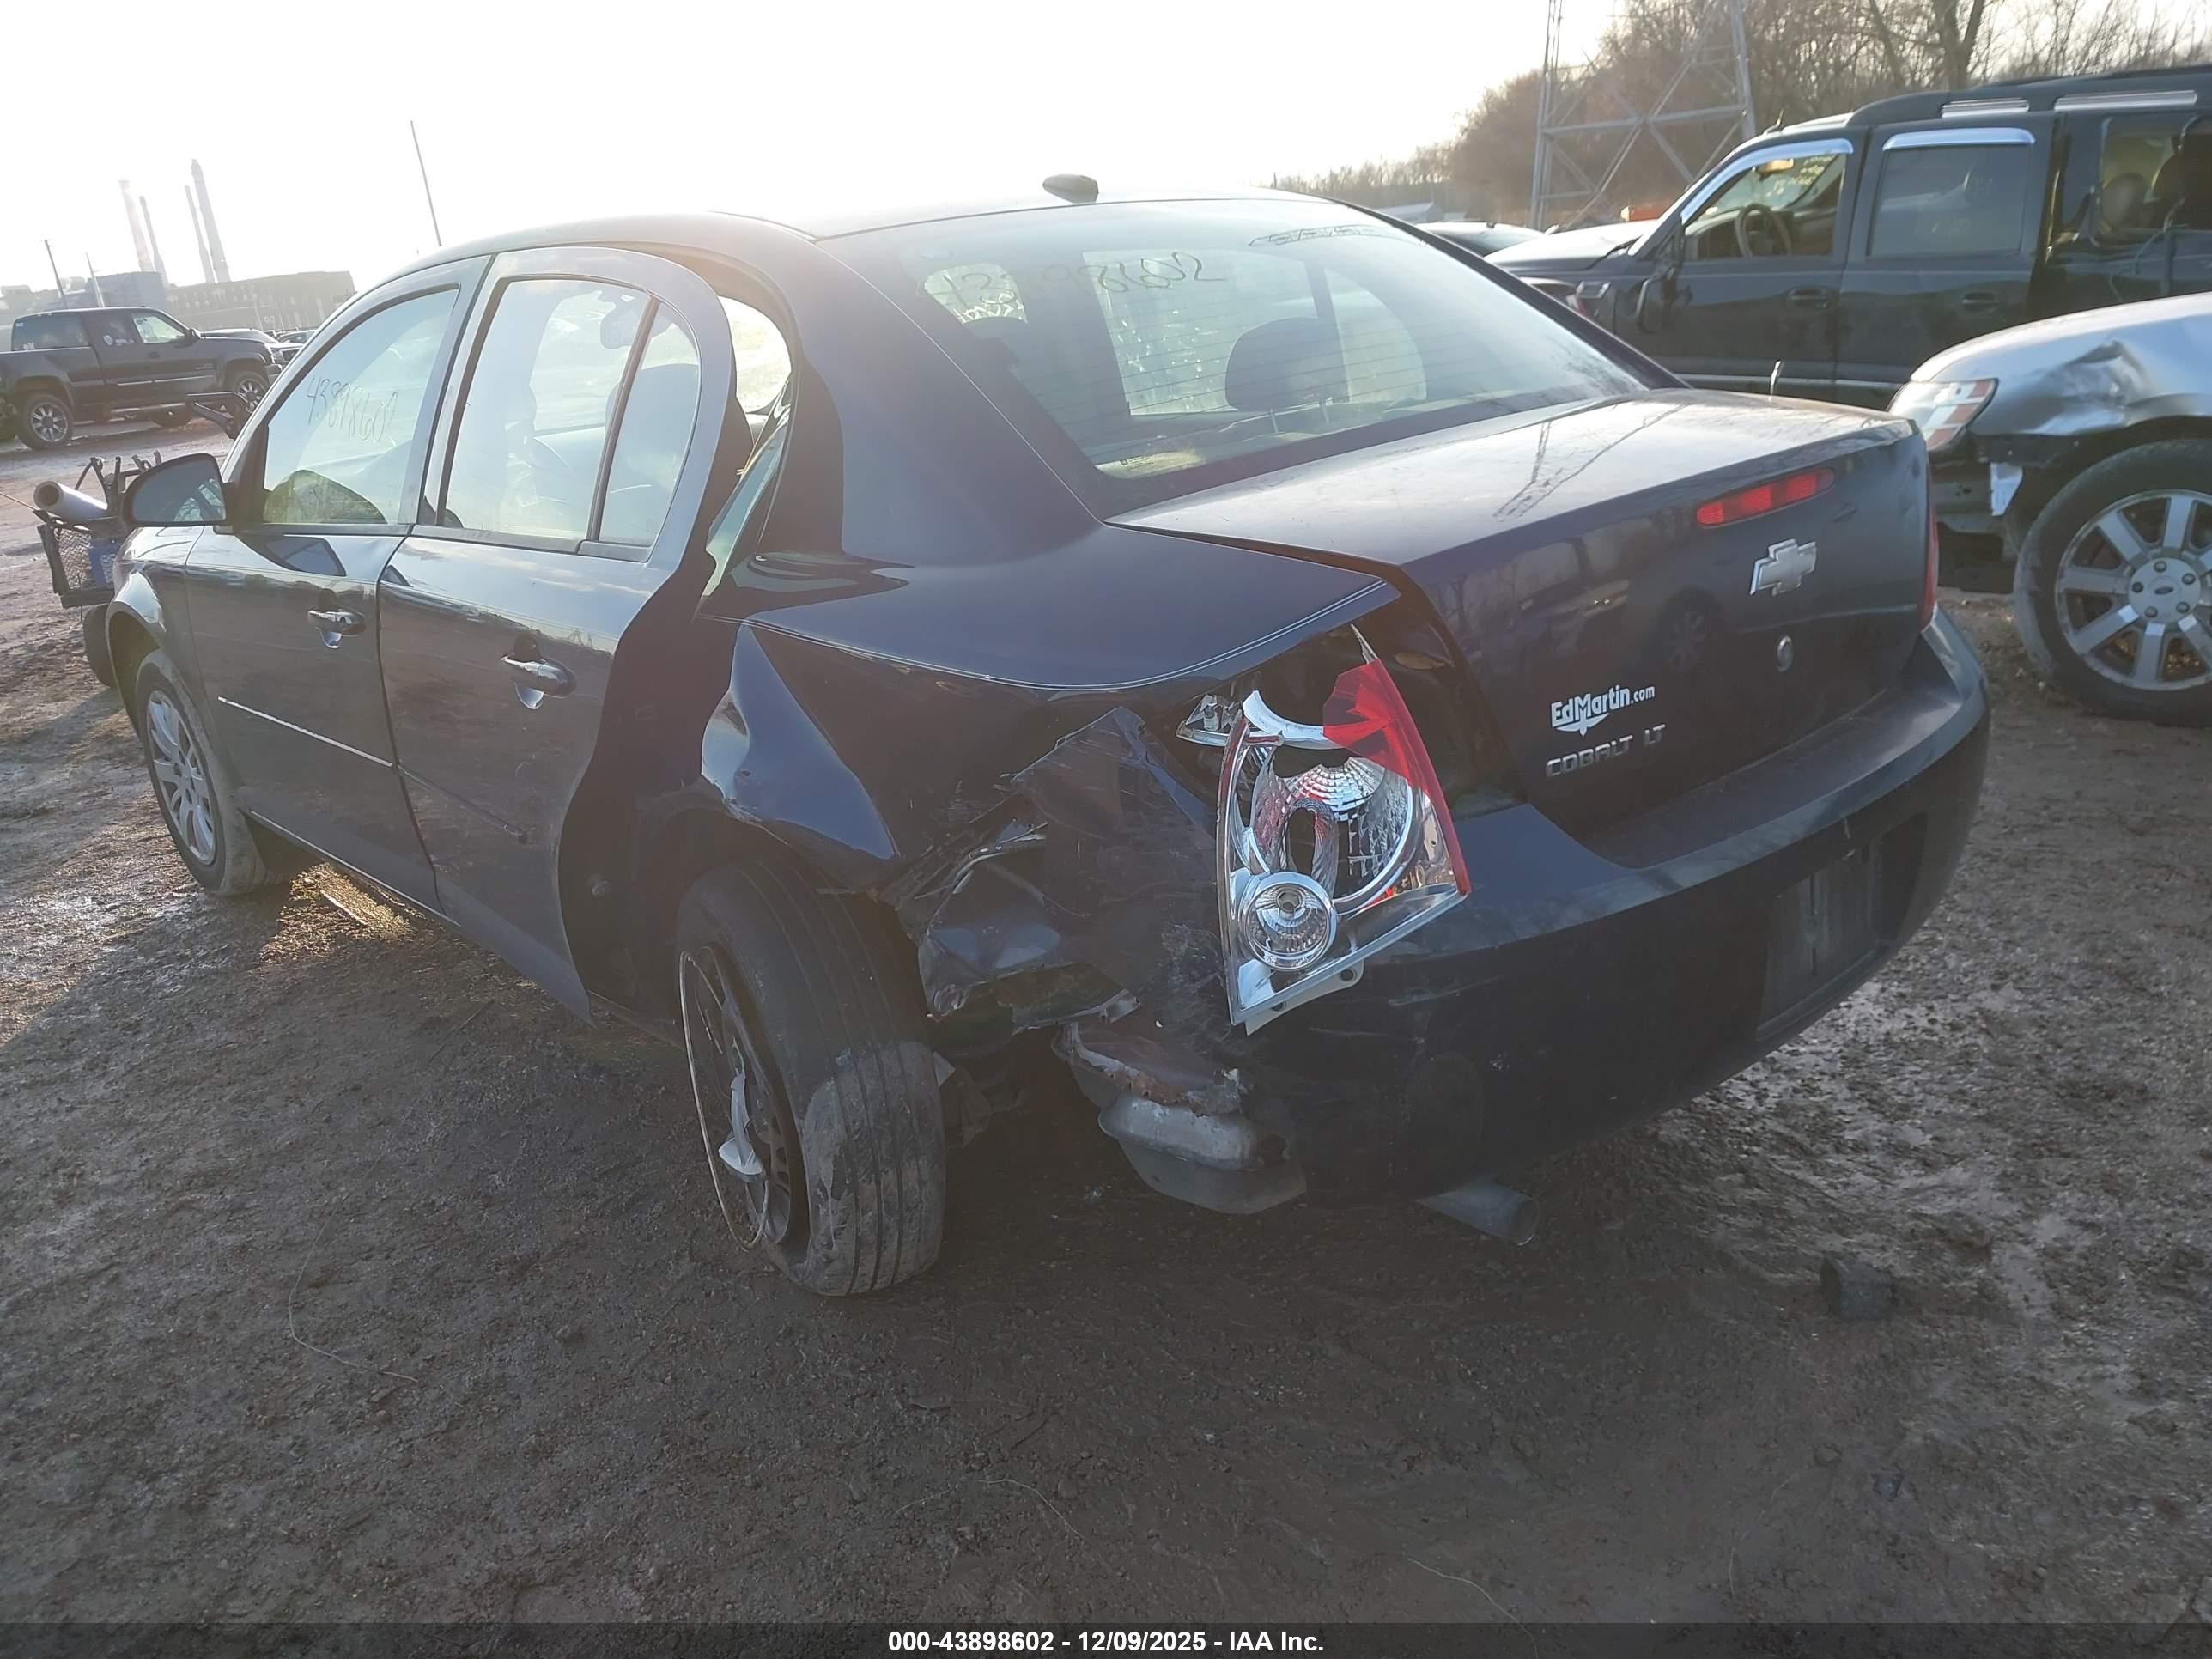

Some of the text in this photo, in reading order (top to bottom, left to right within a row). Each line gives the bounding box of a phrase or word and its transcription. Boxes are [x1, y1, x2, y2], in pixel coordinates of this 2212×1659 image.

[1551, 684, 1656, 730] EdMartin.com
[1547, 724, 1667, 777] COBALT LT
